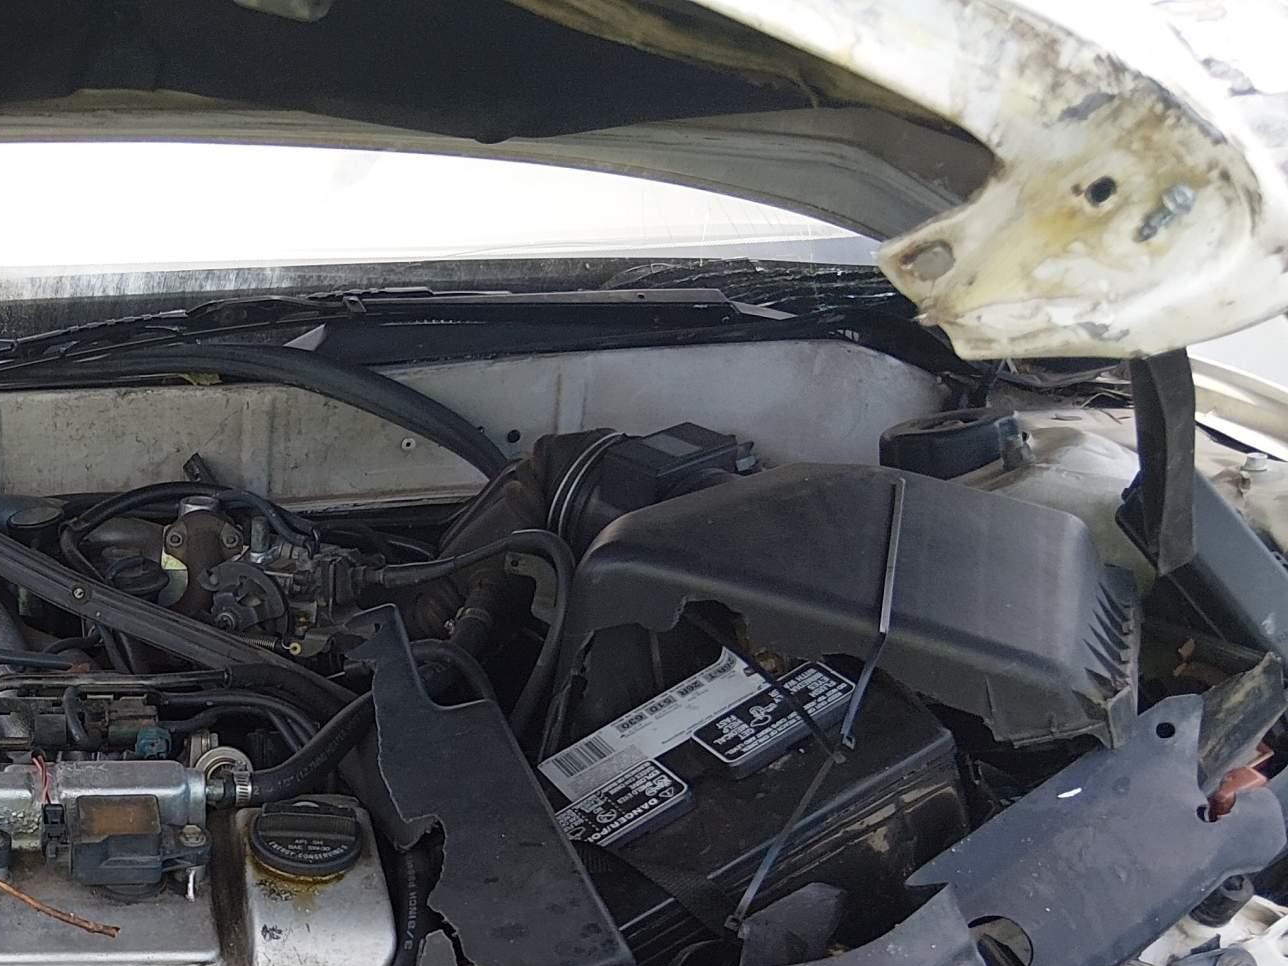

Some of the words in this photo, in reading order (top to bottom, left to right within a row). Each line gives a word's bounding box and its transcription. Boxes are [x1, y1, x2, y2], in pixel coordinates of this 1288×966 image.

[647, 696, 673, 714] 510
[619, 713, 644, 730] 630
[713, 714, 737, 729] FAST
[719, 718, 743, 734] HELP
[711, 722, 749, 746] MEDICAL
[736, 727, 755, 739] GET
